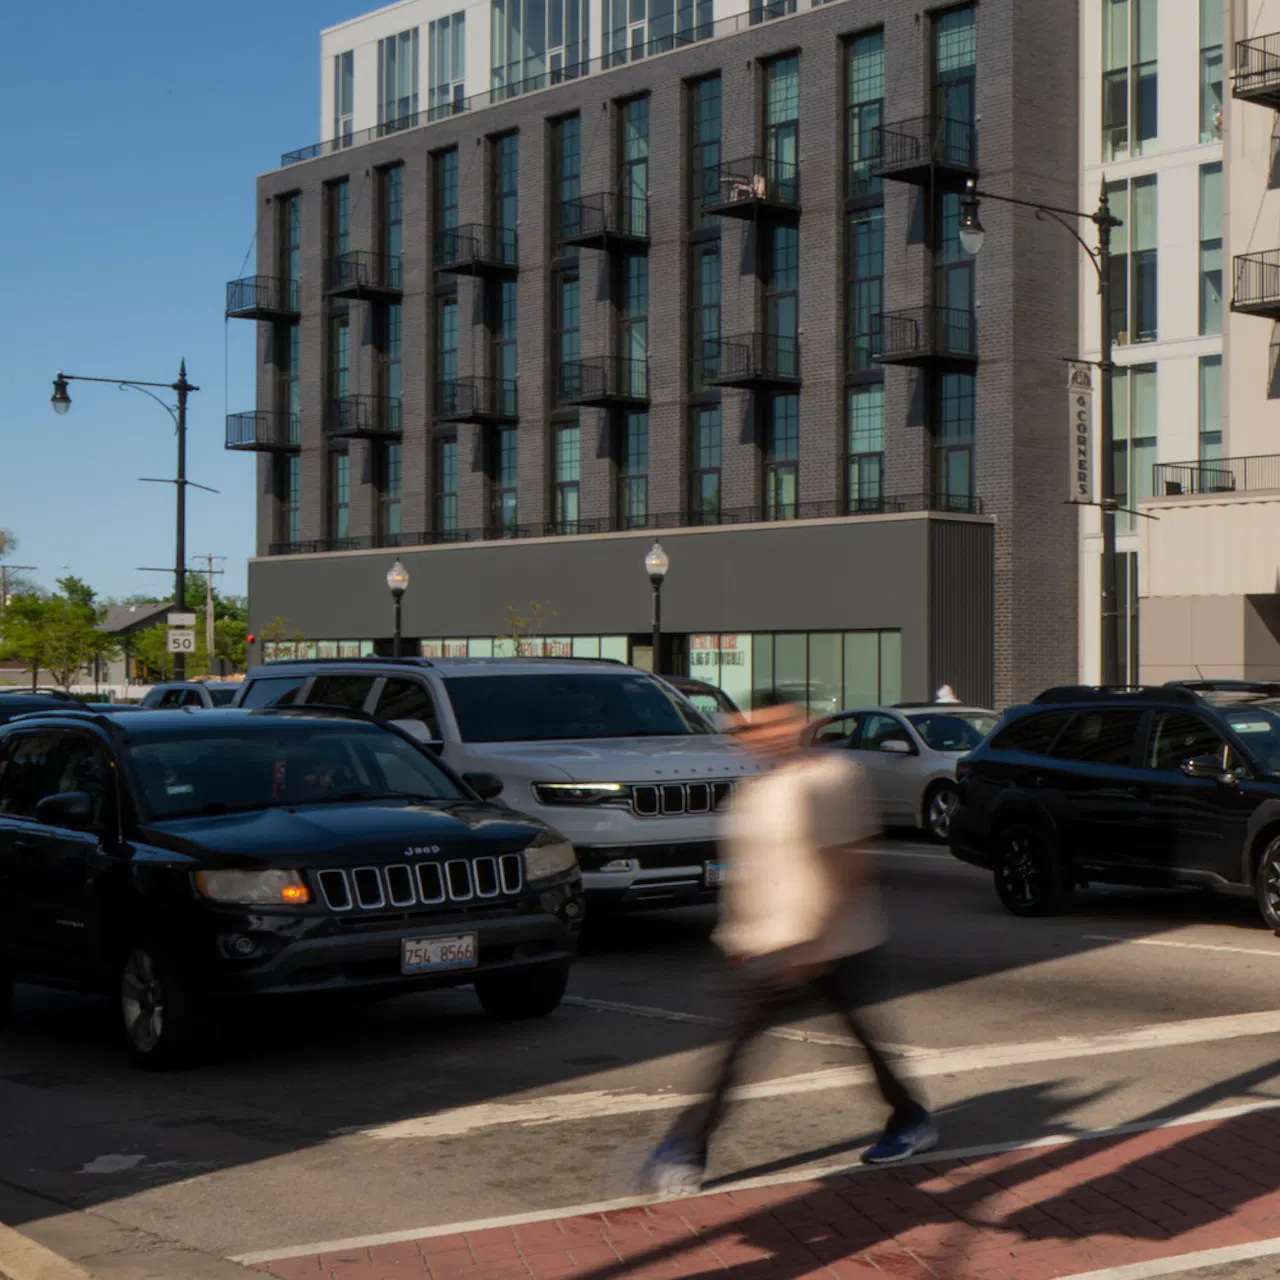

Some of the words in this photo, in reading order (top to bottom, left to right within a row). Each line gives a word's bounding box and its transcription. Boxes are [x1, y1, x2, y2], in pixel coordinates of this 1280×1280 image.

[1076, 410, 1088, 495] CORNERS
[172, 638, 191, 649] 50
[404, 845, 440, 856] Jeep
[405, 948, 431, 966] Z54
[440, 943, 473, 962] 8566
